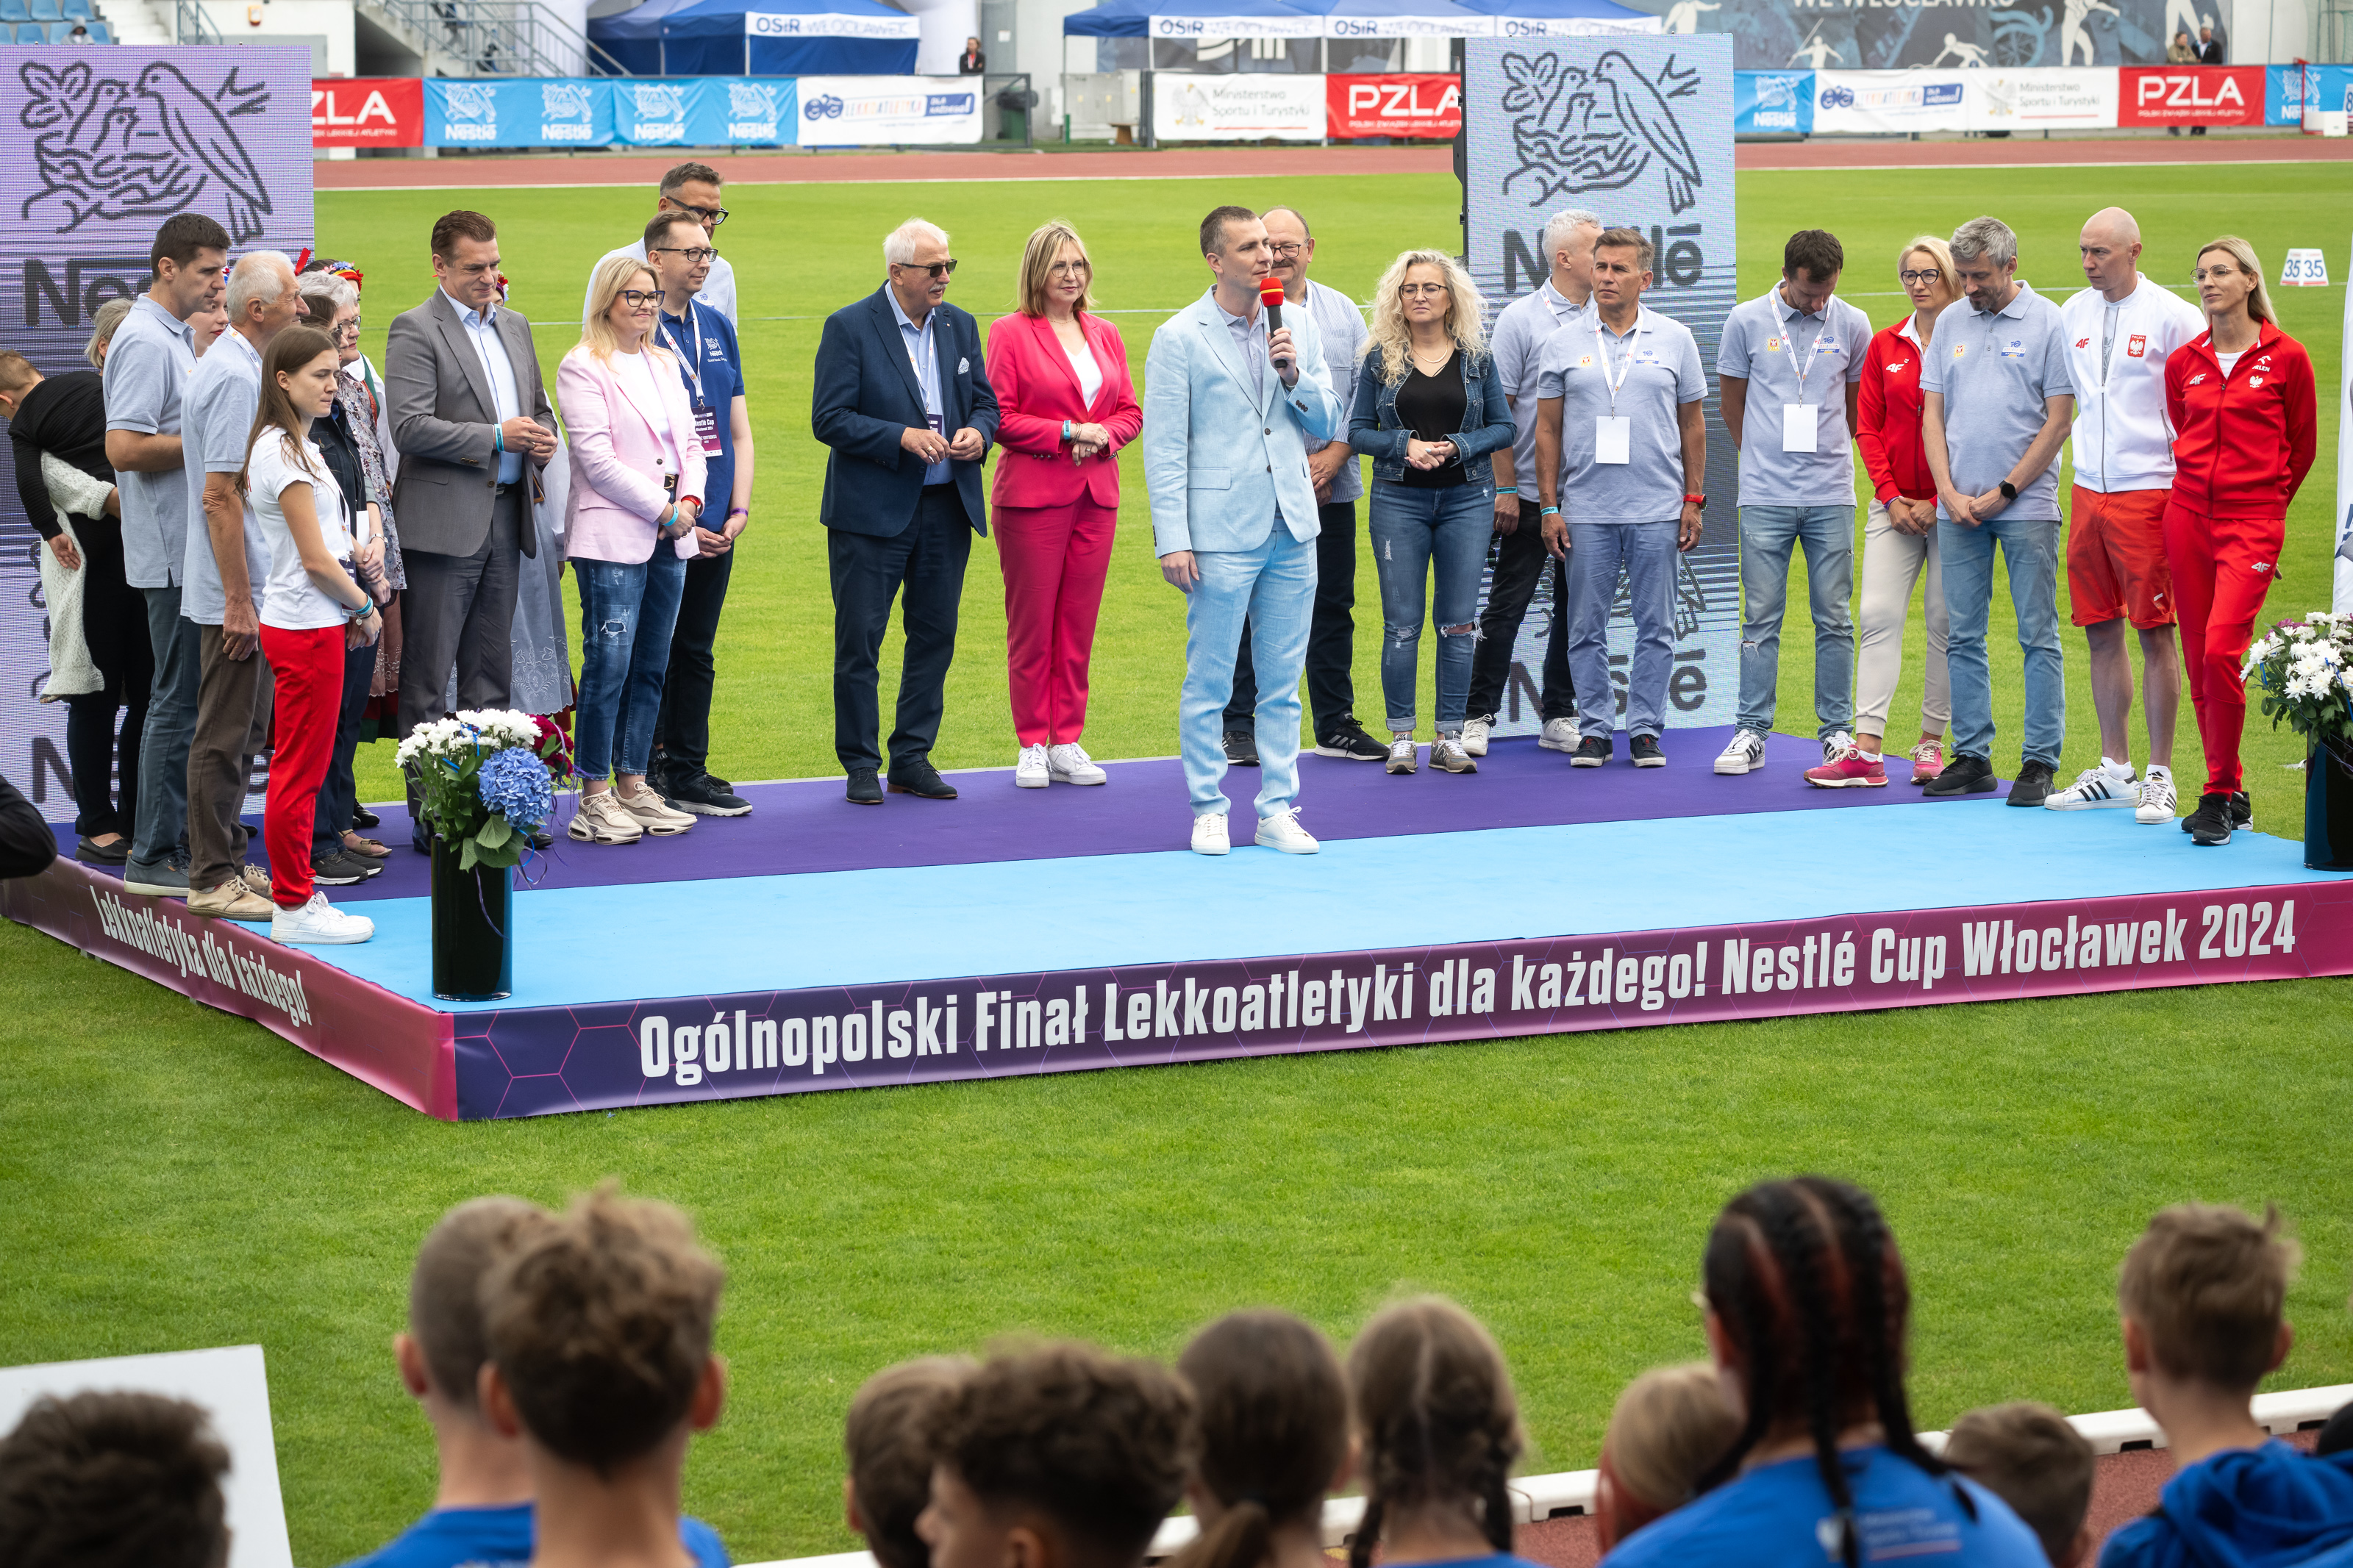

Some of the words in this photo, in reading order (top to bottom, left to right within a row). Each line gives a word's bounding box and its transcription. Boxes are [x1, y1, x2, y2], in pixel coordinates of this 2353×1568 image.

[756, 17, 800, 33] OSiR
[1160, 19, 1204, 35] OSiR
[1335, 20, 1378, 35] OSiR
[2138, 76, 2245, 107] PZLA
[1348, 84, 1462, 117] PZLA
[2285, 259, 2301, 277] 35
[2304, 259, 2324, 277] 35
[2075, 338, 2090, 348] 4F
[1885, 362, 1904, 373] 4F
[2189, 373, 2207, 385] 4F
[2251, 562, 2271, 573] 4F
[89, 885, 208, 978] Lekkoatletyka
[202, 930, 236, 990] dla
[228, 941, 313, 1028] każdego!
[640, 992, 958, 1086] Ogólnopolski
[975, 984, 1090, 1053] Finał
[1104, 961, 1415, 1042] Lekkoatletyki
[1429, 956, 1496, 1019] dla
[1510, 941, 1708, 1012] każdego!
[1722, 929, 1854, 996] Nestlé
[1871, 927, 1947, 989] Cup
[1962, 909, 2188, 978] Włocławek
[2200, 899, 2296, 958] 2024
